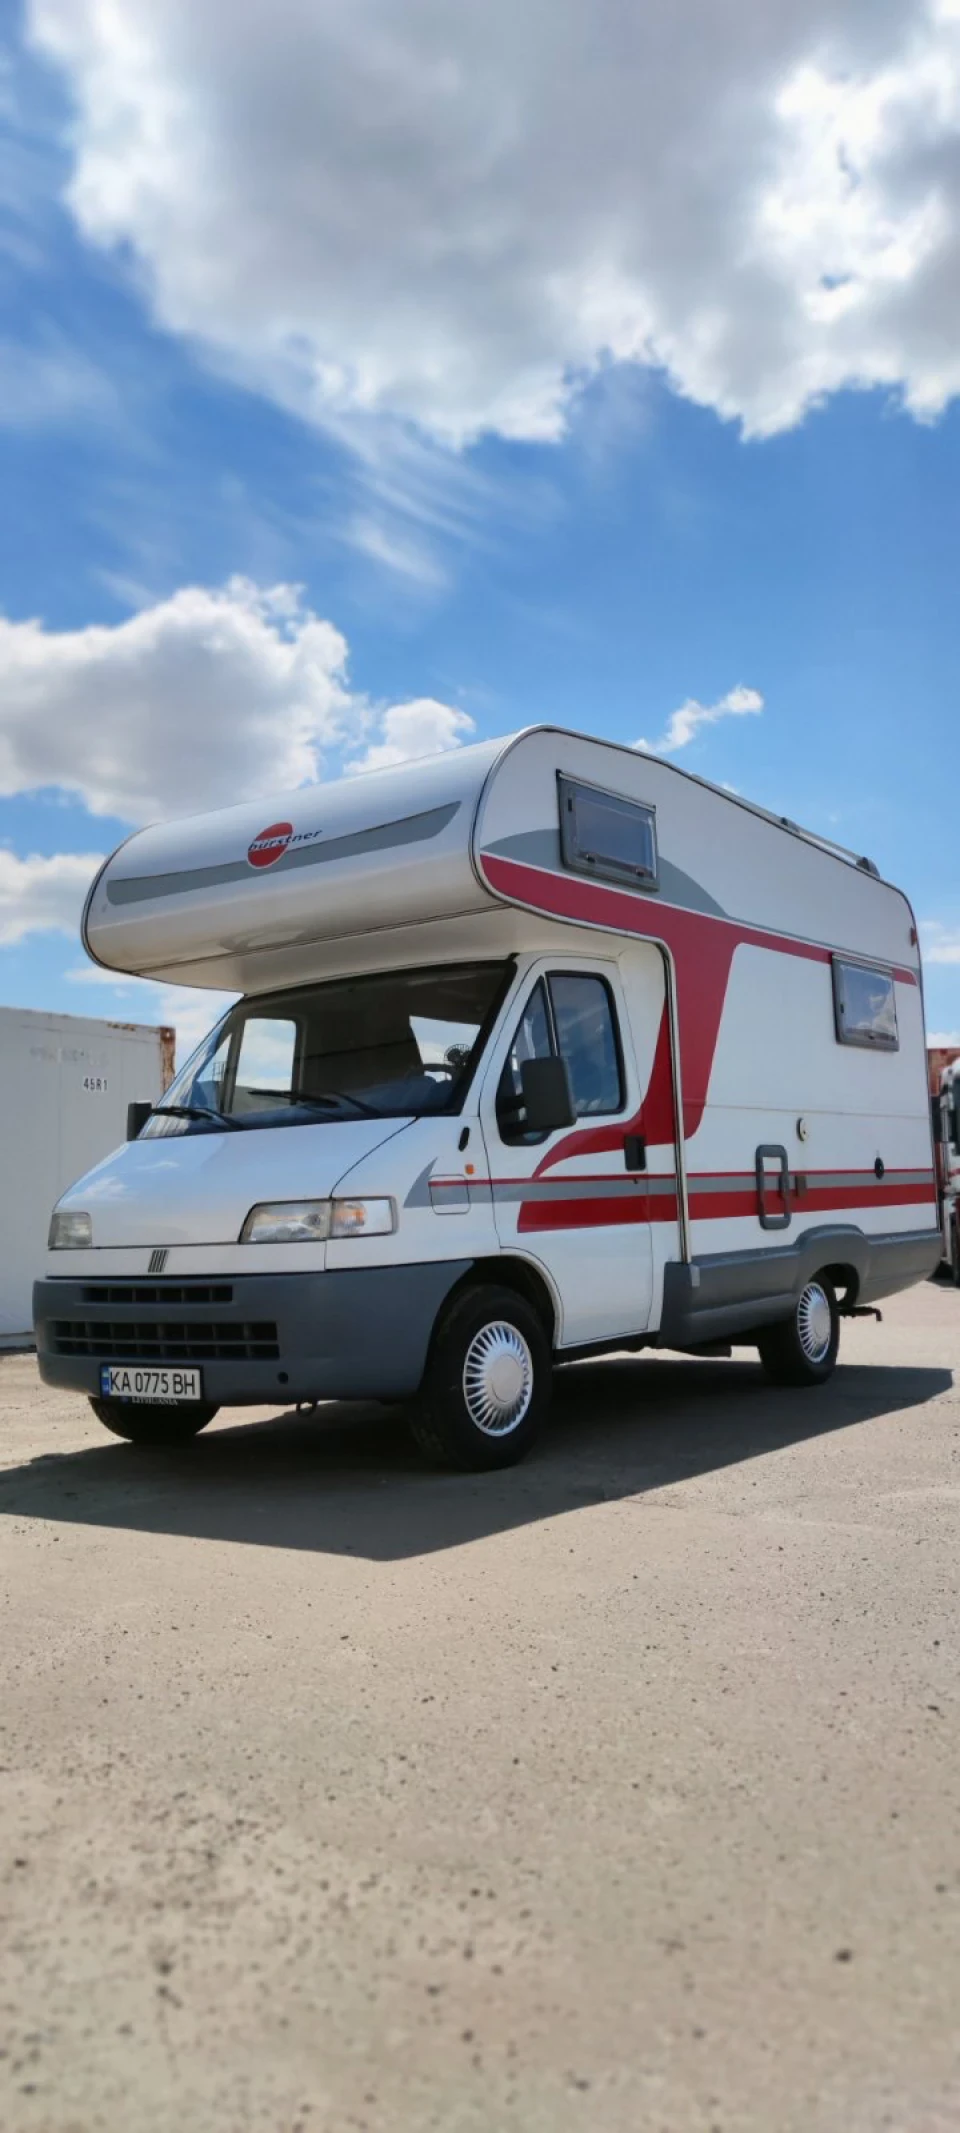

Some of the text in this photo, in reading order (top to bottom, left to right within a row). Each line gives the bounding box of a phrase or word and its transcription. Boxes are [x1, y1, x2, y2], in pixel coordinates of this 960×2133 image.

[83, 1077, 108, 1091] 45R1
[110, 1371, 195, 1396] KA 0775 BH
